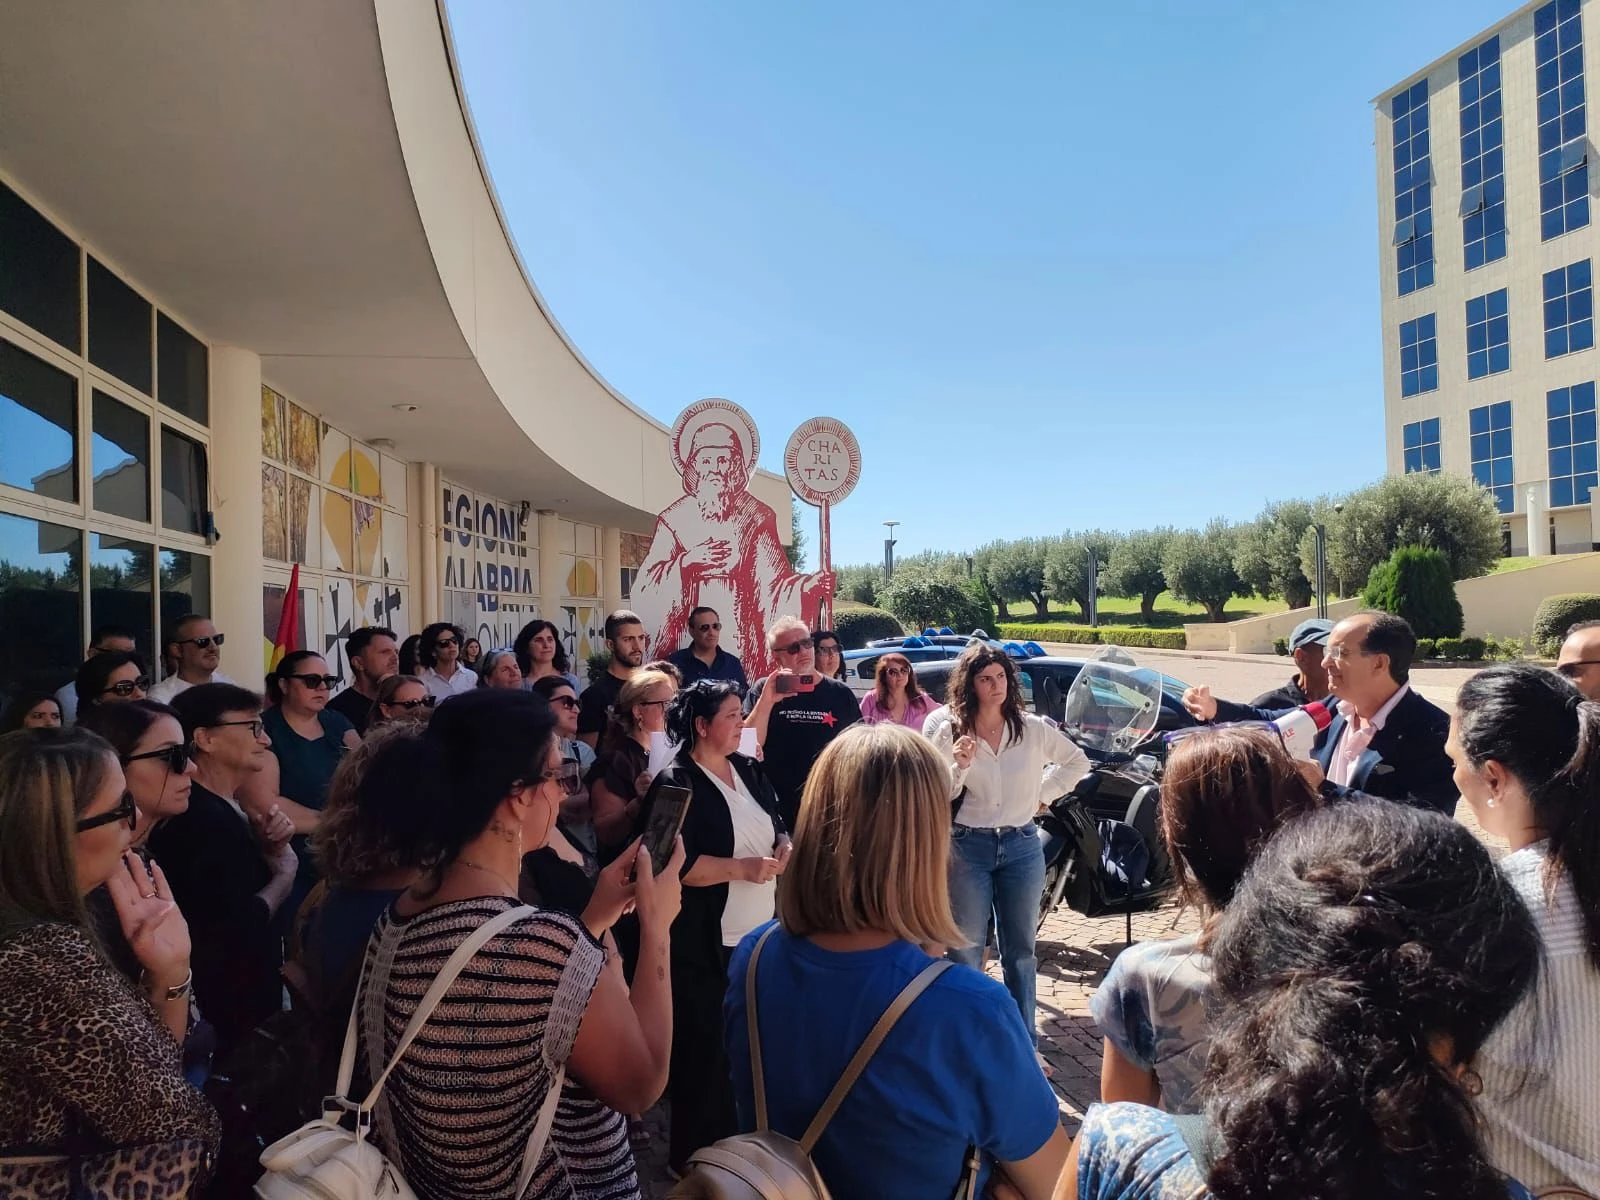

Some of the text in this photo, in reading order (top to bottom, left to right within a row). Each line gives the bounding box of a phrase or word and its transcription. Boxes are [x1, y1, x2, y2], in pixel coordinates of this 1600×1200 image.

[808, 440, 842, 453] CHA
[813, 454, 831, 464] RI
[805, 468, 838, 480] TAS
